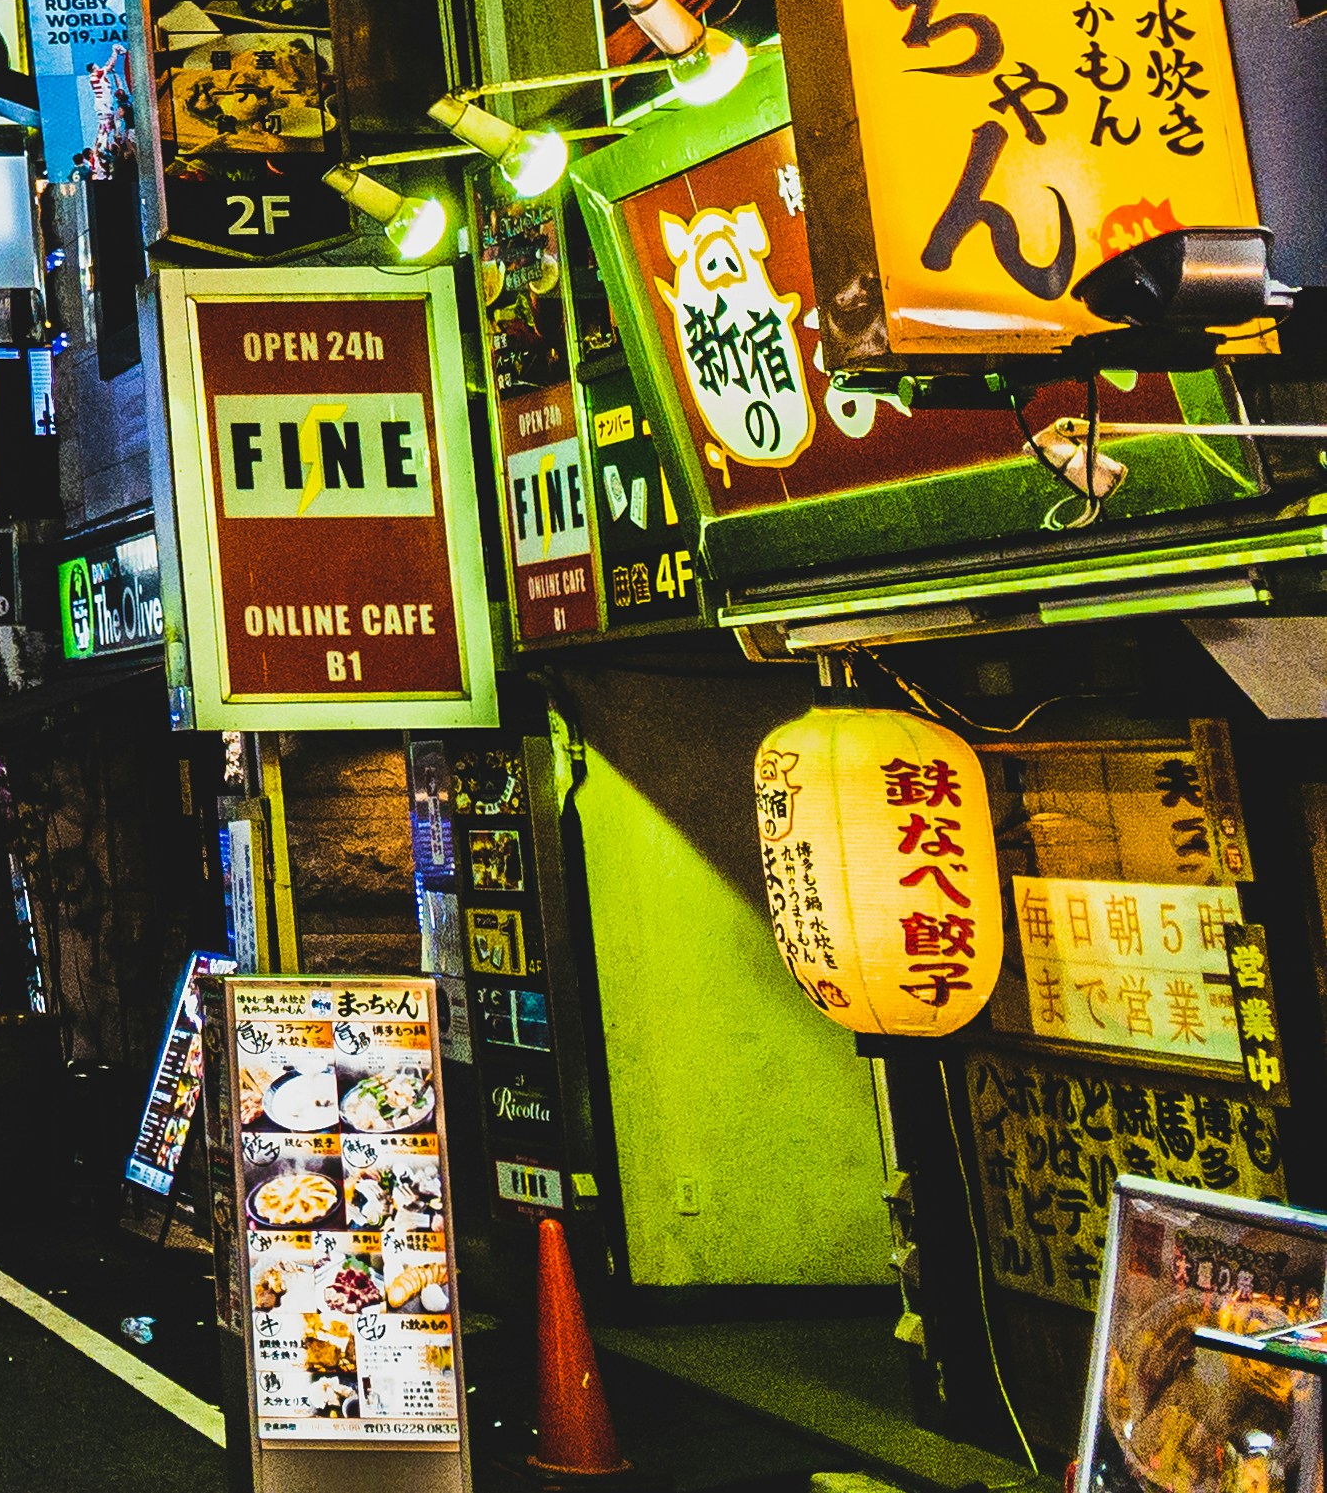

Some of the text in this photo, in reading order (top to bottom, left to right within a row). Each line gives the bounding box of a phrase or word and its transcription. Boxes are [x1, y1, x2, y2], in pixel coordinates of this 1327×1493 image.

[46, 13, 114, 27] WORLD
[47, 29, 96, 46] 2019,
[225, 194, 291, 236] 2F
[242, 331, 385, 362] OPEN 24h
[683, 294, 797, 400] 新宿
[517, 405, 563, 438] OPEN 24h
[596, 416, 632, 439] ナンバー
[746, 400, 781, 453] の
[230, 419, 421, 490] FINE
[511, 463, 585, 542] FINE
[527, 566, 587, 602] ONLINE CAFE
[612, 550, 693, 608] 麻雀 4F
[93, 569, 164, 646] The Olive
[244, 603, 437, 637] ONLINE CAFE
[552, 608, 567, 631] B1
[326, 650, 363, 682] B1
[880, 758, 977, 1010] 鉄なべ餃子
[1022, 887, 1237, 960] 毎日朝5時
[337, 990, 420, 1020] まっちゃん
[1031, 966, 1208, 1046] まで営業
[1231, 944, 1282, 1094] 営業中
[275, 1024, 324, 1034] コラーゲン
[492, 1085, 551, 1123] Ricotta
[259, 1316, 279, 1336] 牛
